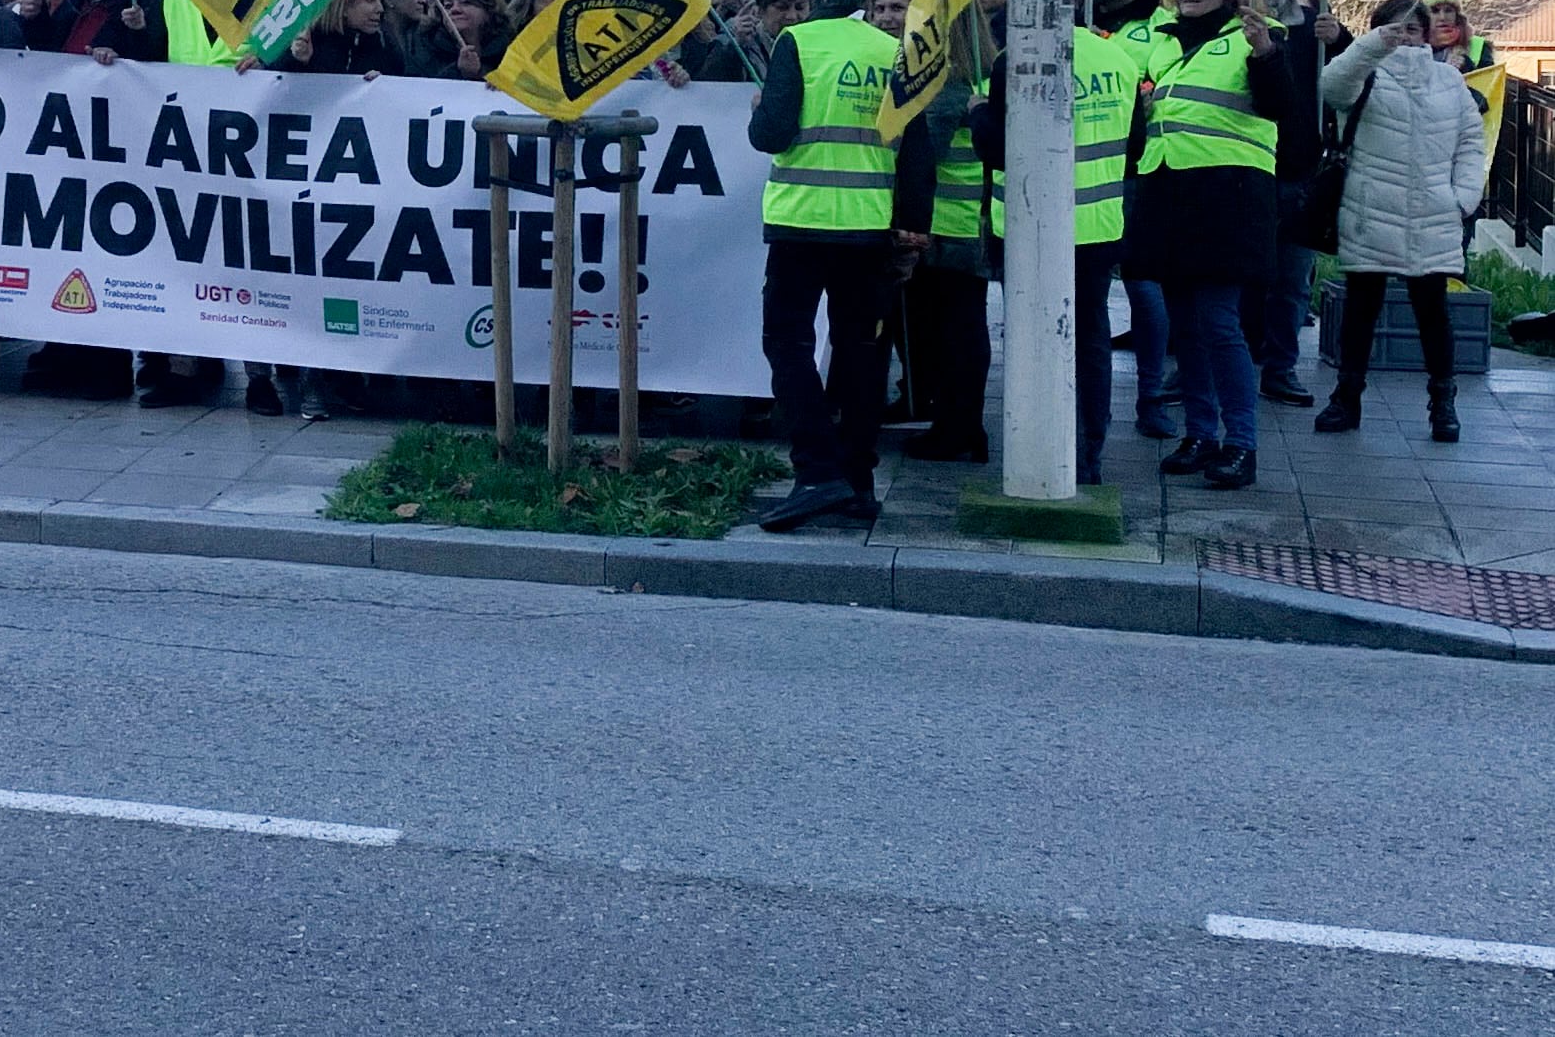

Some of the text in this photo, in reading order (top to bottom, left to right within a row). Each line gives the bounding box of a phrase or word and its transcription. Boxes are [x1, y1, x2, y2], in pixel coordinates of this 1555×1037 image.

[582, 13, 640, 64] ATI
[579, 16, 674, 89] INDEPENDIENTES
[1090, 71, 1123, 95] ATI
[25, 91, 127, 163] AL
[145, 92, 382, 185] ÁREA
[104, 277, 166, 291] Agrupación de
[64, 291, 84, 305] ATI
[104, 288, 158, 301] Trabajadores
[195, 283, 233, 303] UGT
[103, 299, 166, 314] Independientes
[363, 305, 410, 319] Sindicato
[200, 311, 287, 328] Sanidad Cantabria
[363, 318, 376, 327] de
[326, 322, 358, 332] SATSE
[363, 329, 400, 340] Cantabria
